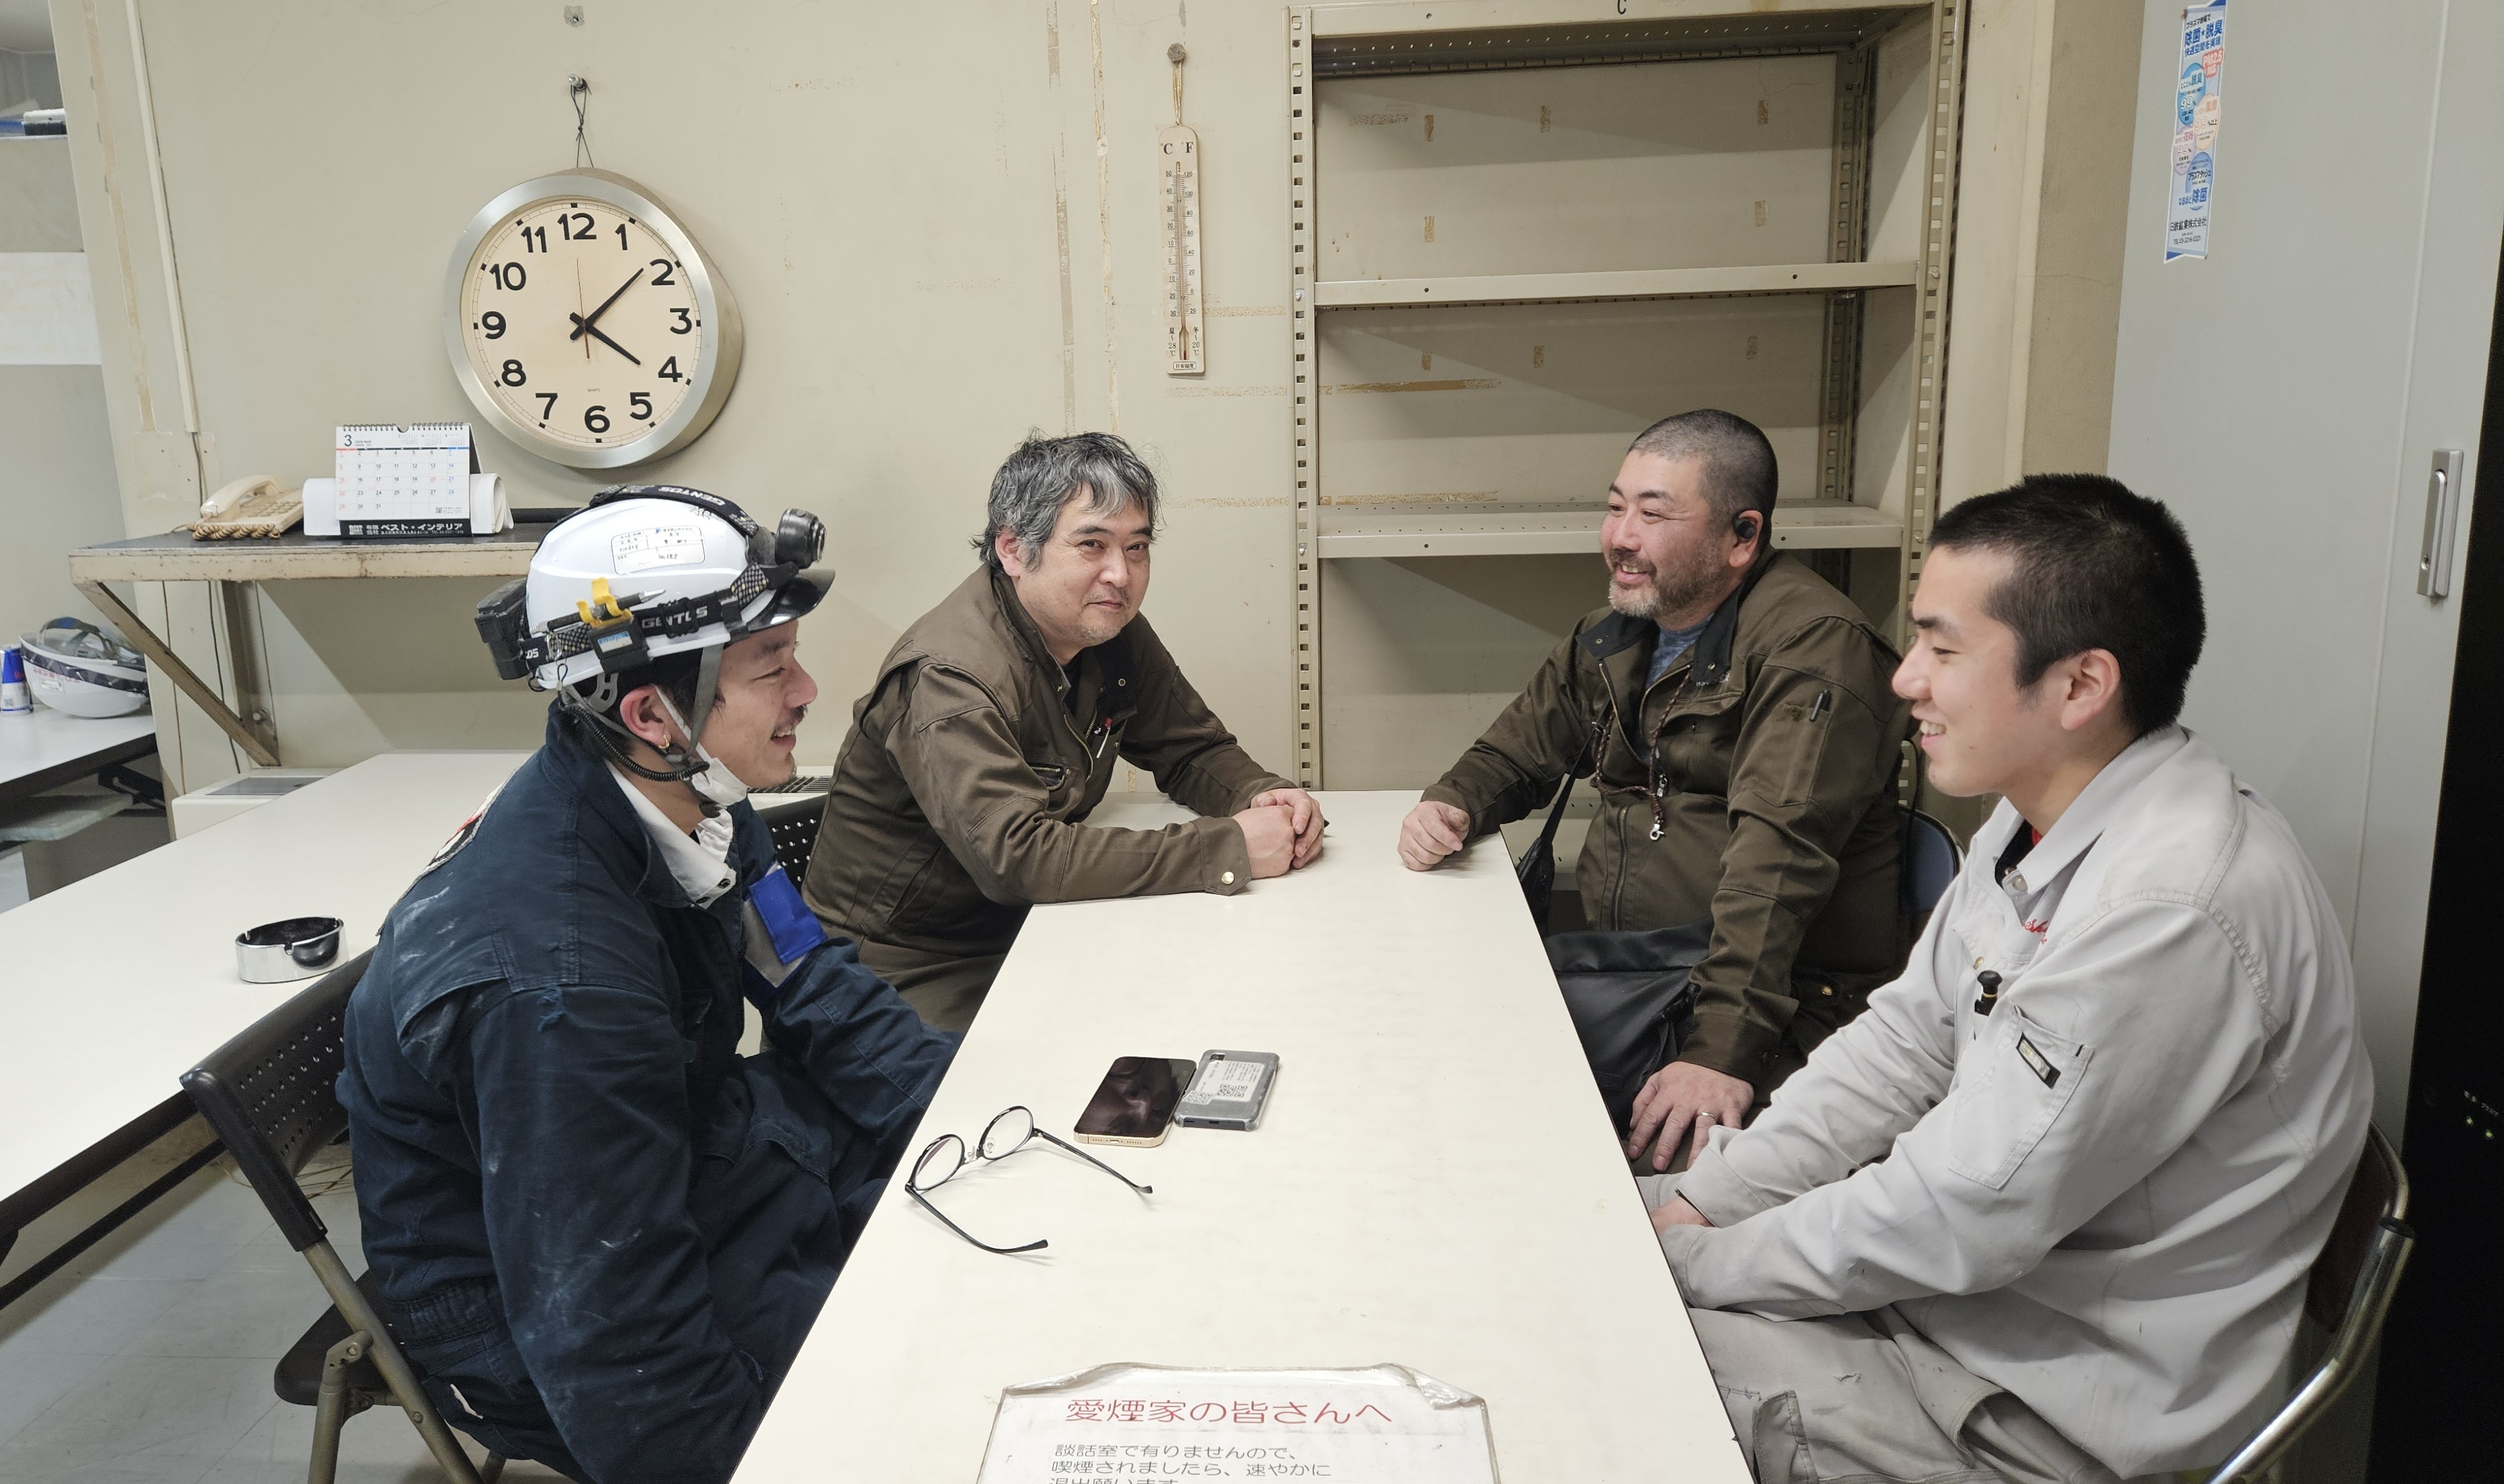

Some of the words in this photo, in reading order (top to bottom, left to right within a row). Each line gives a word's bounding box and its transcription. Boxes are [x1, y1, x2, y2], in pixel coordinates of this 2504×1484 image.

[521, 226, 547, 253] 11
[558, 213, 597, 240] 12
[615, 224, 628, 251] 1
[489, 262, 527, 291] 10
[649, 259, 676, 286] 2
[482, 311, 507, 340] 9
[669, 308, 692, 335] 3
[501, 359, 527, 387] 8
[658, 356, 683, 383] 4
[535, 393, 558, 420] 7
[584, 405, 611, 433] 6
[629, 392, 653, 420] 5
[344, 434, 352, 447] 3
[658, 486, 726, 506] GENTOS
[1066, 1399, 1393, 1424] 愛煙家の皆さんへ
[1055, 1444, 1295, 1460] 談話室で有りませんので、
[1051, 1461, 1230, 1476] 喫煙されましたら、
[1246, 1463, 1331, 1476] 速やかに
